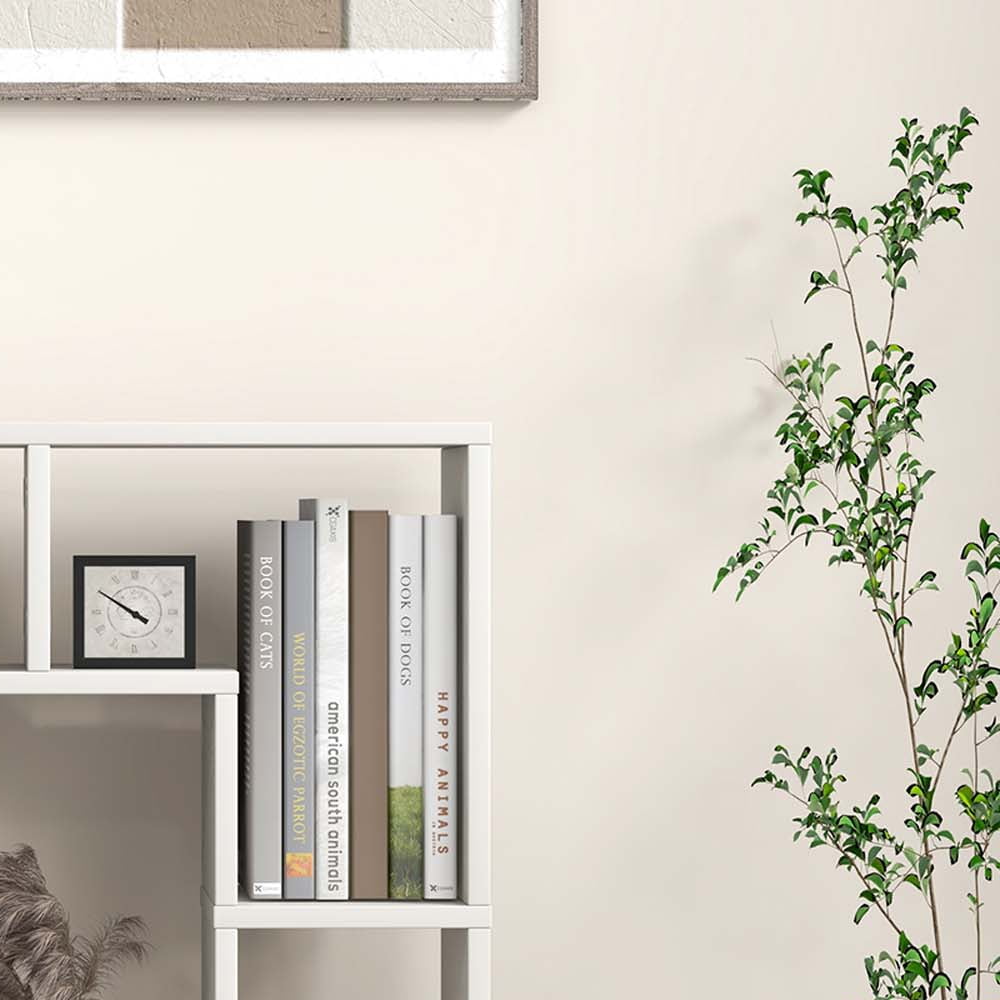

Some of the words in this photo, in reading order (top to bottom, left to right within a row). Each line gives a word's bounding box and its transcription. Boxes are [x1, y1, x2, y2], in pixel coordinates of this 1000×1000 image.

[260, 556, 273, 599] BOOK
[400, 566, 412, 609] BOOK
[260, 605, 273, 626] OF
[400, 616, 412, 636] OF
[259, 632, 273, 670] CATS
[292, 633, 306, 686] WORLD
[400, 643, 412, 686] DOGS
[292, 691, 306, 711] OF
[437, 692, 449, 752] HAPPY
[292, 717, 306, 784] EGZOTIC
[328, 702, 343, 776] american
[292, 787, 306, 843] PARROT
[328, 781, 343, 825] south
[437, 768, 449, 854] ANIMALS
[328, 830, 343, 892] animals
